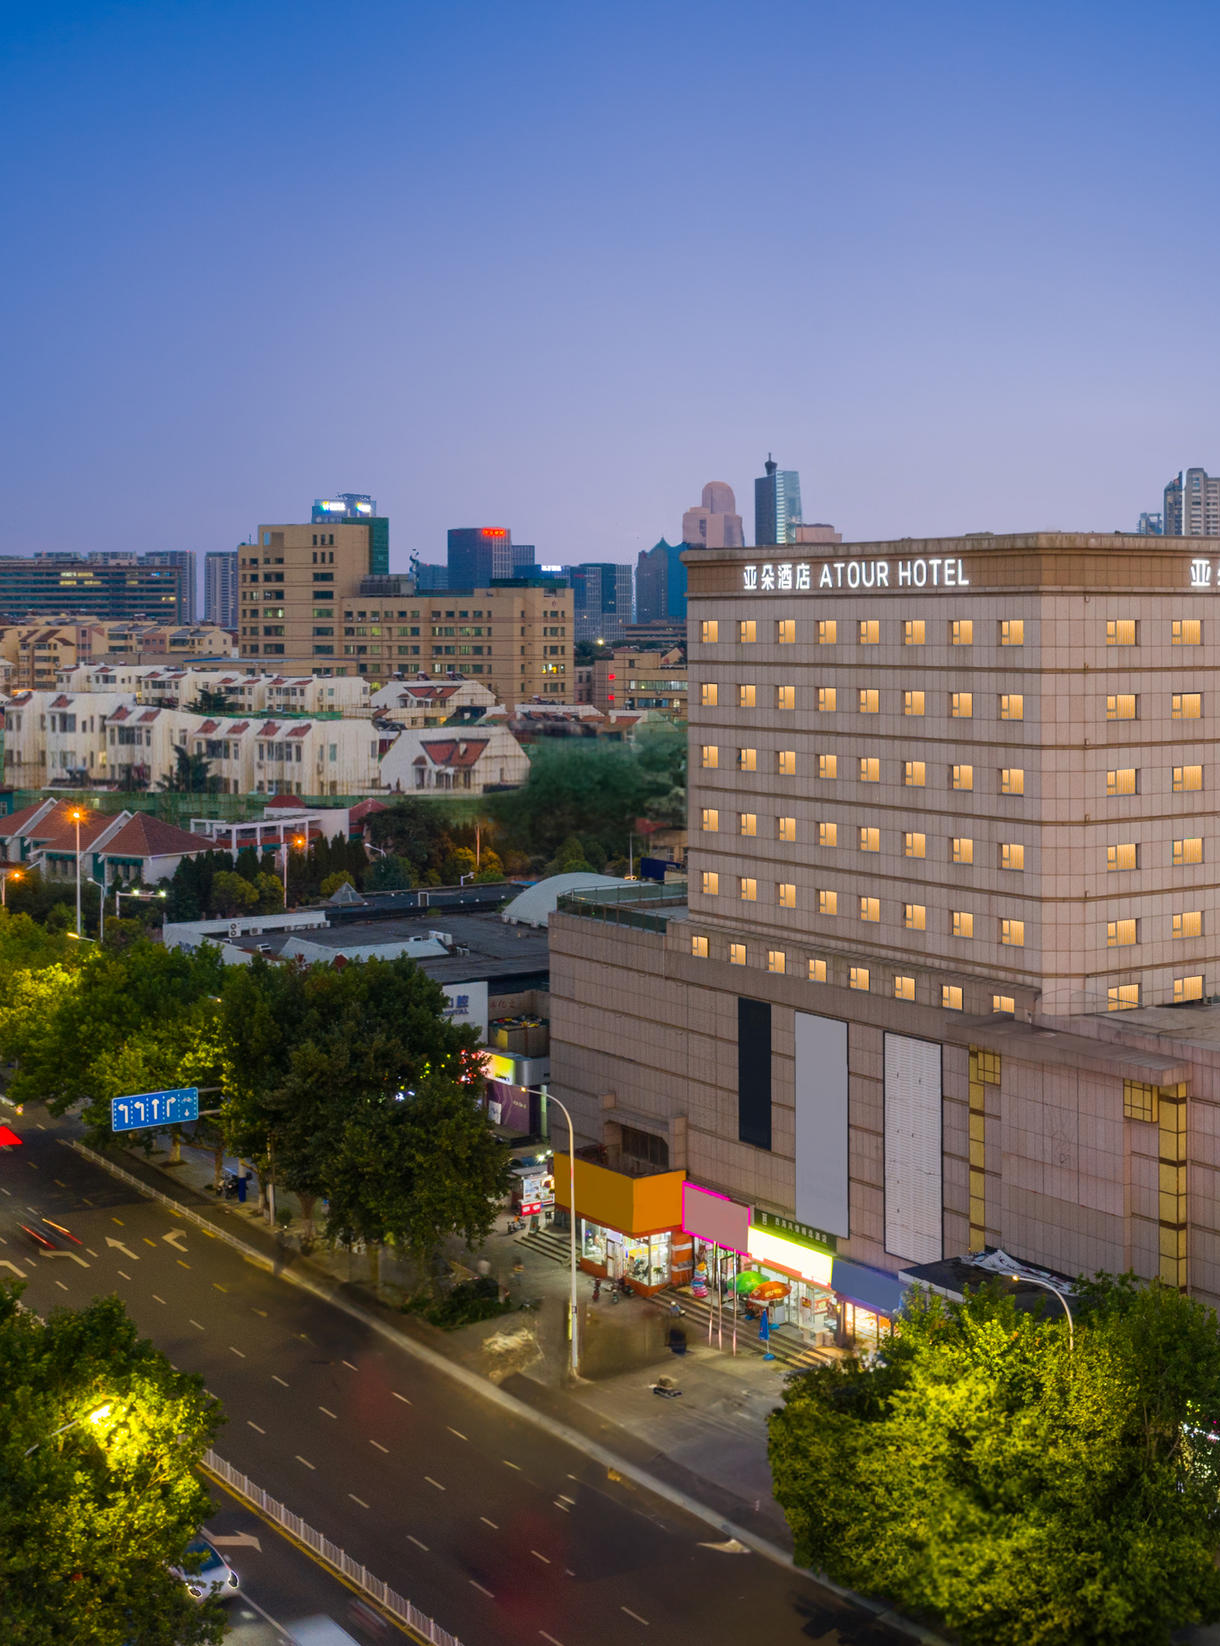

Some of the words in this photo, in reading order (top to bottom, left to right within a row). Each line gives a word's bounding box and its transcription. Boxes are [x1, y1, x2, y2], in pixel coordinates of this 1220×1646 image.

[743, 563, 811, 591] 亚朵酒店
[819, 561, 889, 589] ATOUR
[898, 558, 970, 587] HOTEL
